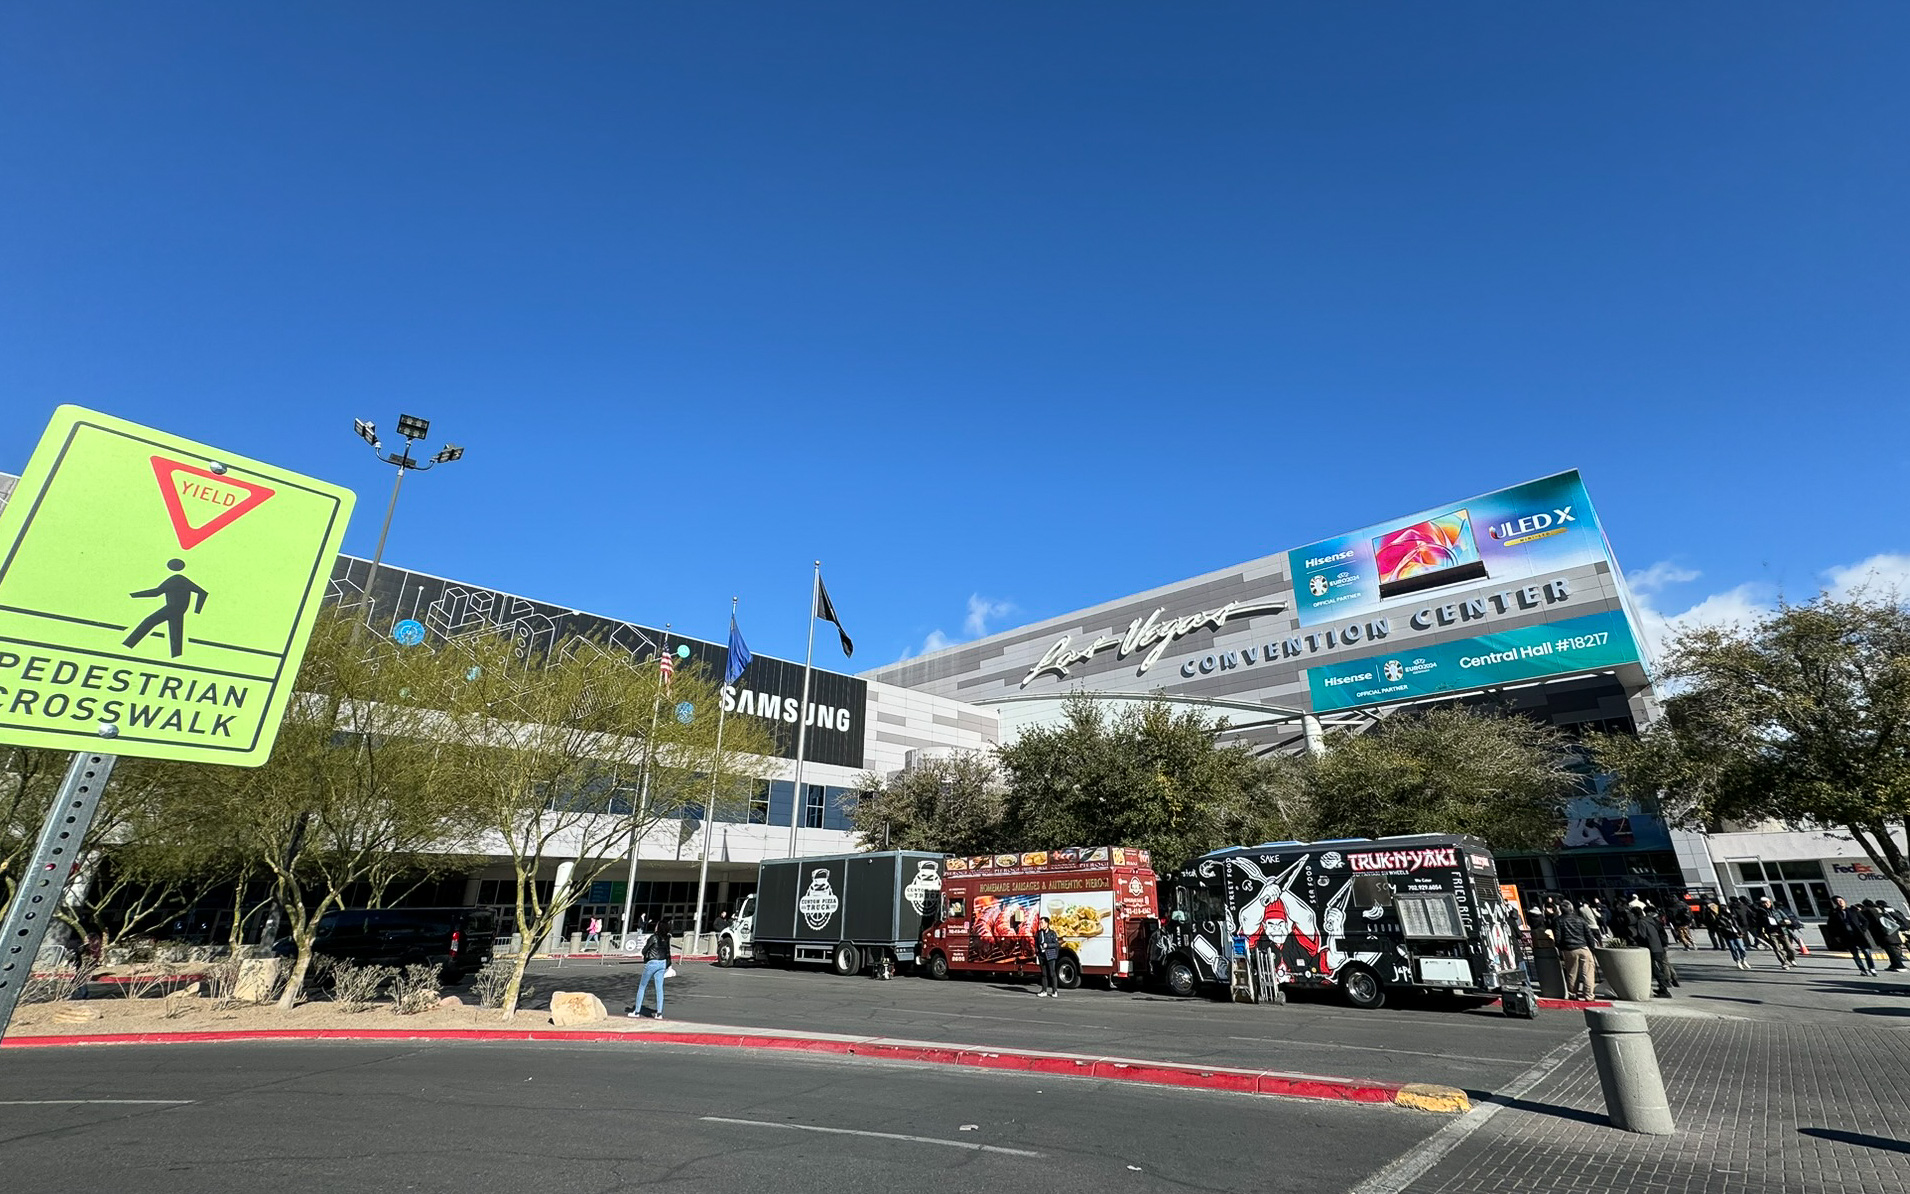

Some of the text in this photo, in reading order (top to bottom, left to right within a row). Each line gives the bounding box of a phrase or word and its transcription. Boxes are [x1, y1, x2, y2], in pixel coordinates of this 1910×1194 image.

[182, 480, 236, 507] YIELD
[1552, 505, 1576, 525] X
[1305, 549, 1355, 569] Hisense
[1312, 592, 1362, 608] OFFICIAL PARTNER
[1119, 601, 1288, 672] Vegas
[1180, 576, 1573, 679] CONVENTION CENTER
[1459, 631, 1609, 669] Central Hall #18217
[0, 652, 249, 709] PEDESTRIAN
[1324, 672, 1374, 688] Hisense
[1356, 684, 1409, 698] OFFICIAL PARTNER
[719, 685, 850, 732] SAMSUNG
[1260, 854, 1280, 864] SAKE
[1347, 848, 1459, 872] TRUK-N-YAKI
[1832, 862, 1874, 874] FedEx
[979, 882, 1010, 893] HOMEMADE
[1012, 880, 1040, 892] SAUSAGES
[1041, 881, 1047, 890] &
[1048, 879, 1083, 890] AUTHENTIC
[1305, 865, 1316, 904] SEA FOOD
[1857, 873, 1890, 882] Office
[1227, 880, 1236, 911] STREET
[1451, 871, 1474, 931] FRIED RICE
